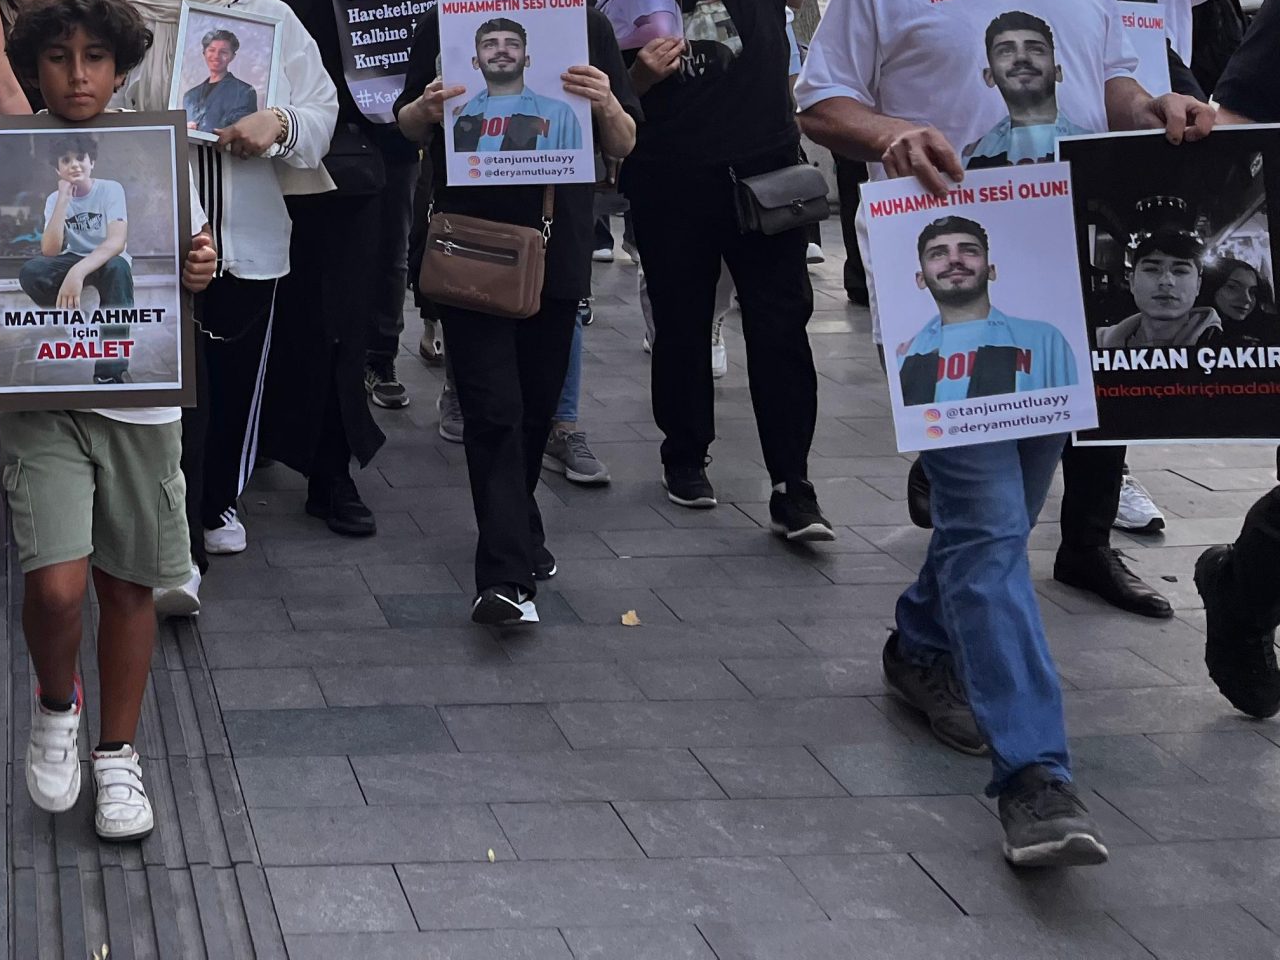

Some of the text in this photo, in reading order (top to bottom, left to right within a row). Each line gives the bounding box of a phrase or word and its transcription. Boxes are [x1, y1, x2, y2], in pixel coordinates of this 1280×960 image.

[1122, 12, 1164, 30] ESİ OLUN!
[351, 27, 408, 46] Kalbine
[484, 154, 575, 166] @tanjumutluayy
[484, 167, 576, 178] @deryamutluay75
[869, 180, 1069, 218] MUHAMMETİN SESİ OLUN!
[4, 308, 166, 326] MATTIA AHMET
[72, 327, 99, 340] için
[37, 340, 135, 360] ADALET
[1092, 348, 1189, 372] HAKAN
[946, 393, 1070, 419] @tanjumutluayy
[947, 410, 1072, 436] @deryamutluay75
